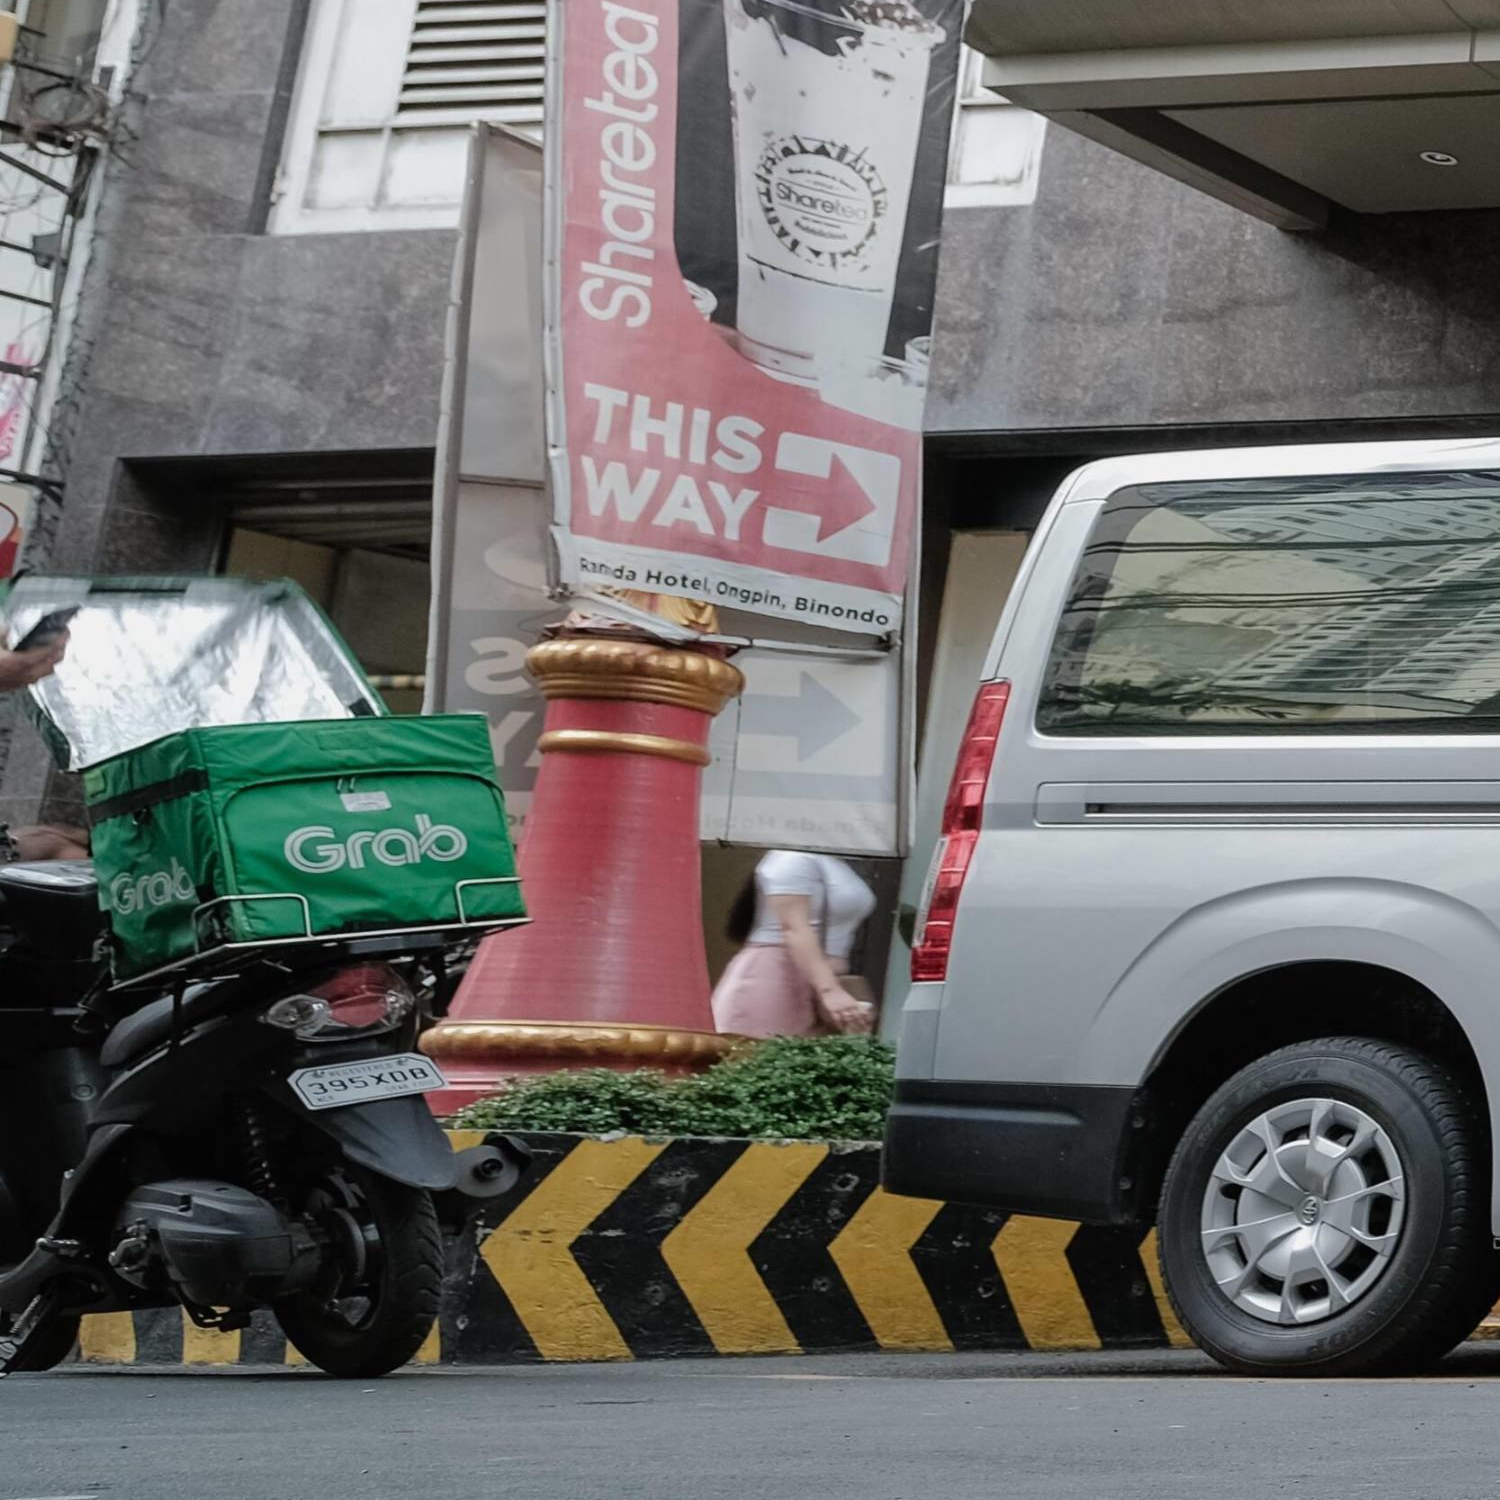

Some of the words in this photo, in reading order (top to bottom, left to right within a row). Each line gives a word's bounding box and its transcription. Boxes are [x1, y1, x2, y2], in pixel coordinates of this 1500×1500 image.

[579, 1, 659, 328] Sharetea
[584, 382, 765, 475] THIS
[580, 454, 761, 541] WAY
[646, 570, 711, 593] Hotel,
[716, 581, 787, 610] Ongpin,
[795, 597, 889, 626] Binondo
[284, 814, 468, 874] Grab
[109, 856, 196, 916] Grab
[307, 1067, 429, 1095] 395XDB
